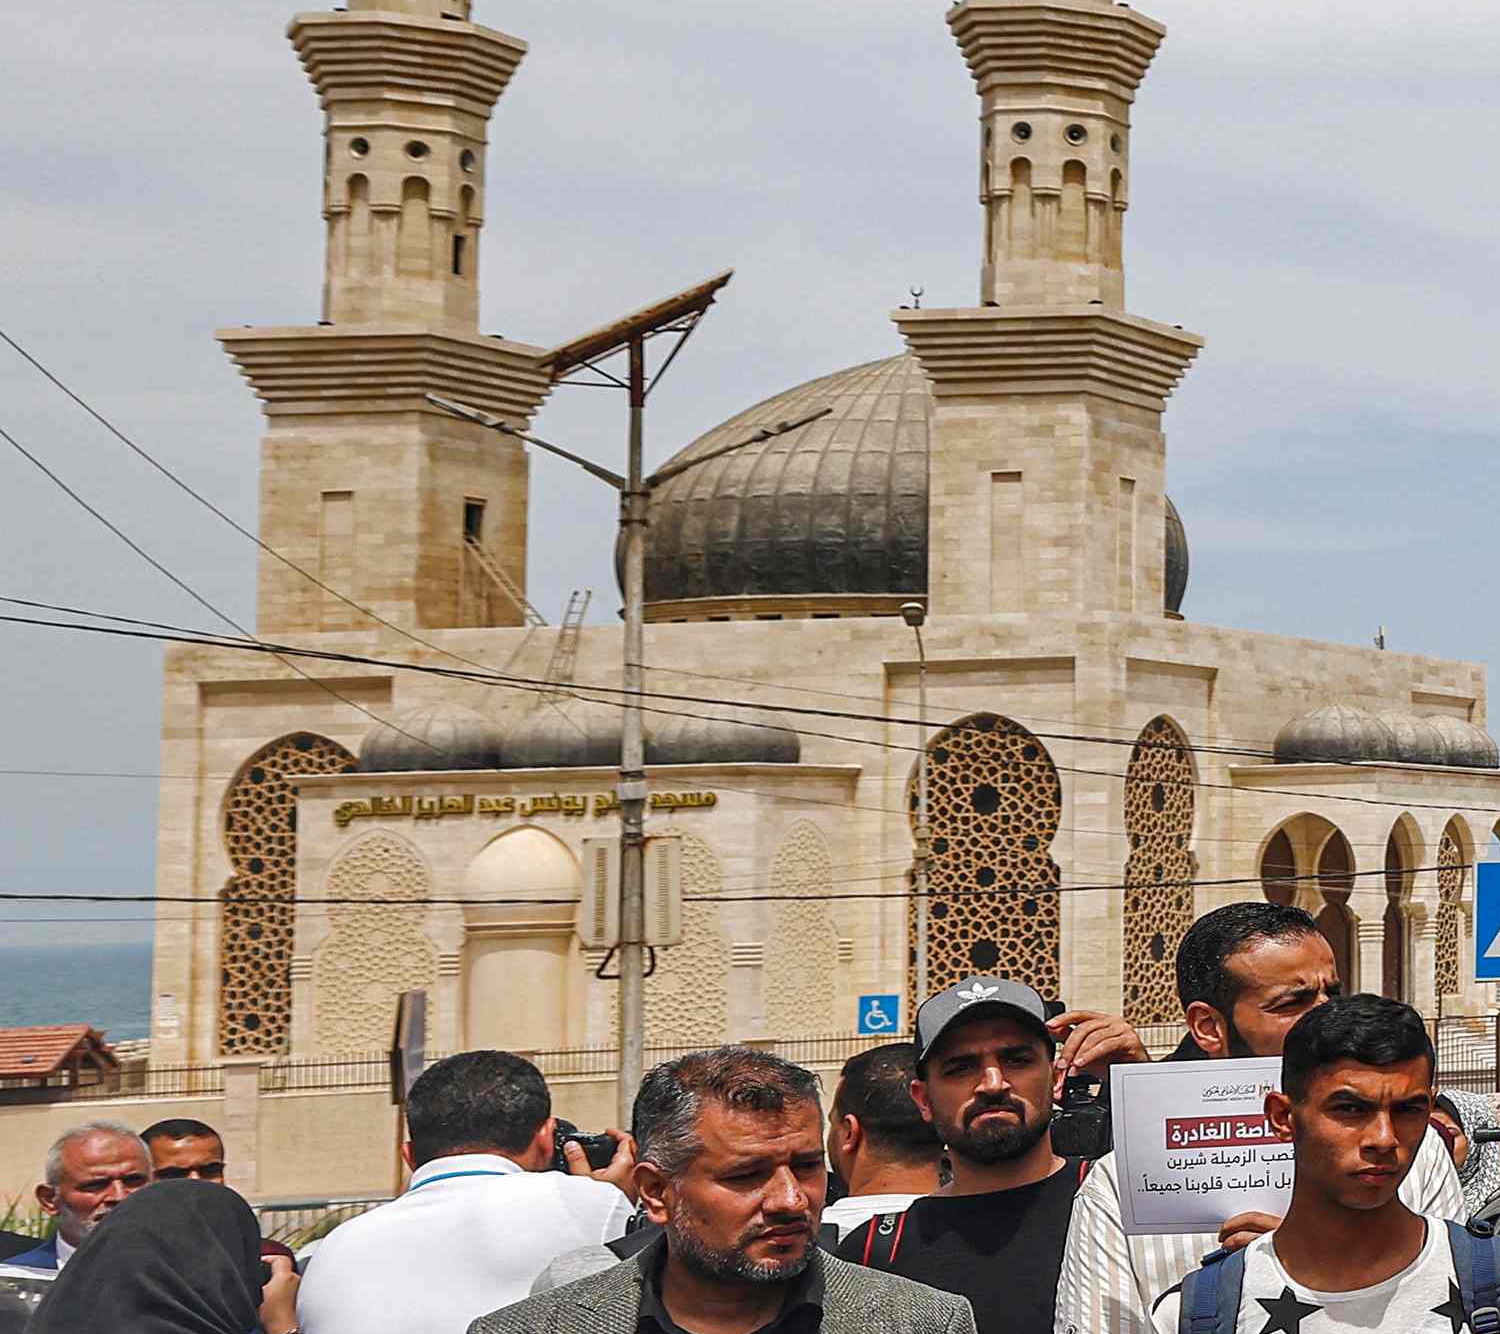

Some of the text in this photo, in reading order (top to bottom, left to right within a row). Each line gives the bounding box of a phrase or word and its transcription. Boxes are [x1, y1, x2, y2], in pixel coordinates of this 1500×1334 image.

[1171, 1120, 1232, 1146] الغادرة
[1166, 1152, 1207, 1171] شيرين
[1210, 1148, 1257, 1168] الزميلة
[1184, 1176, 1223, 1196] قلوبنا
[1226, 1170, 1271, 1190] أصابت
